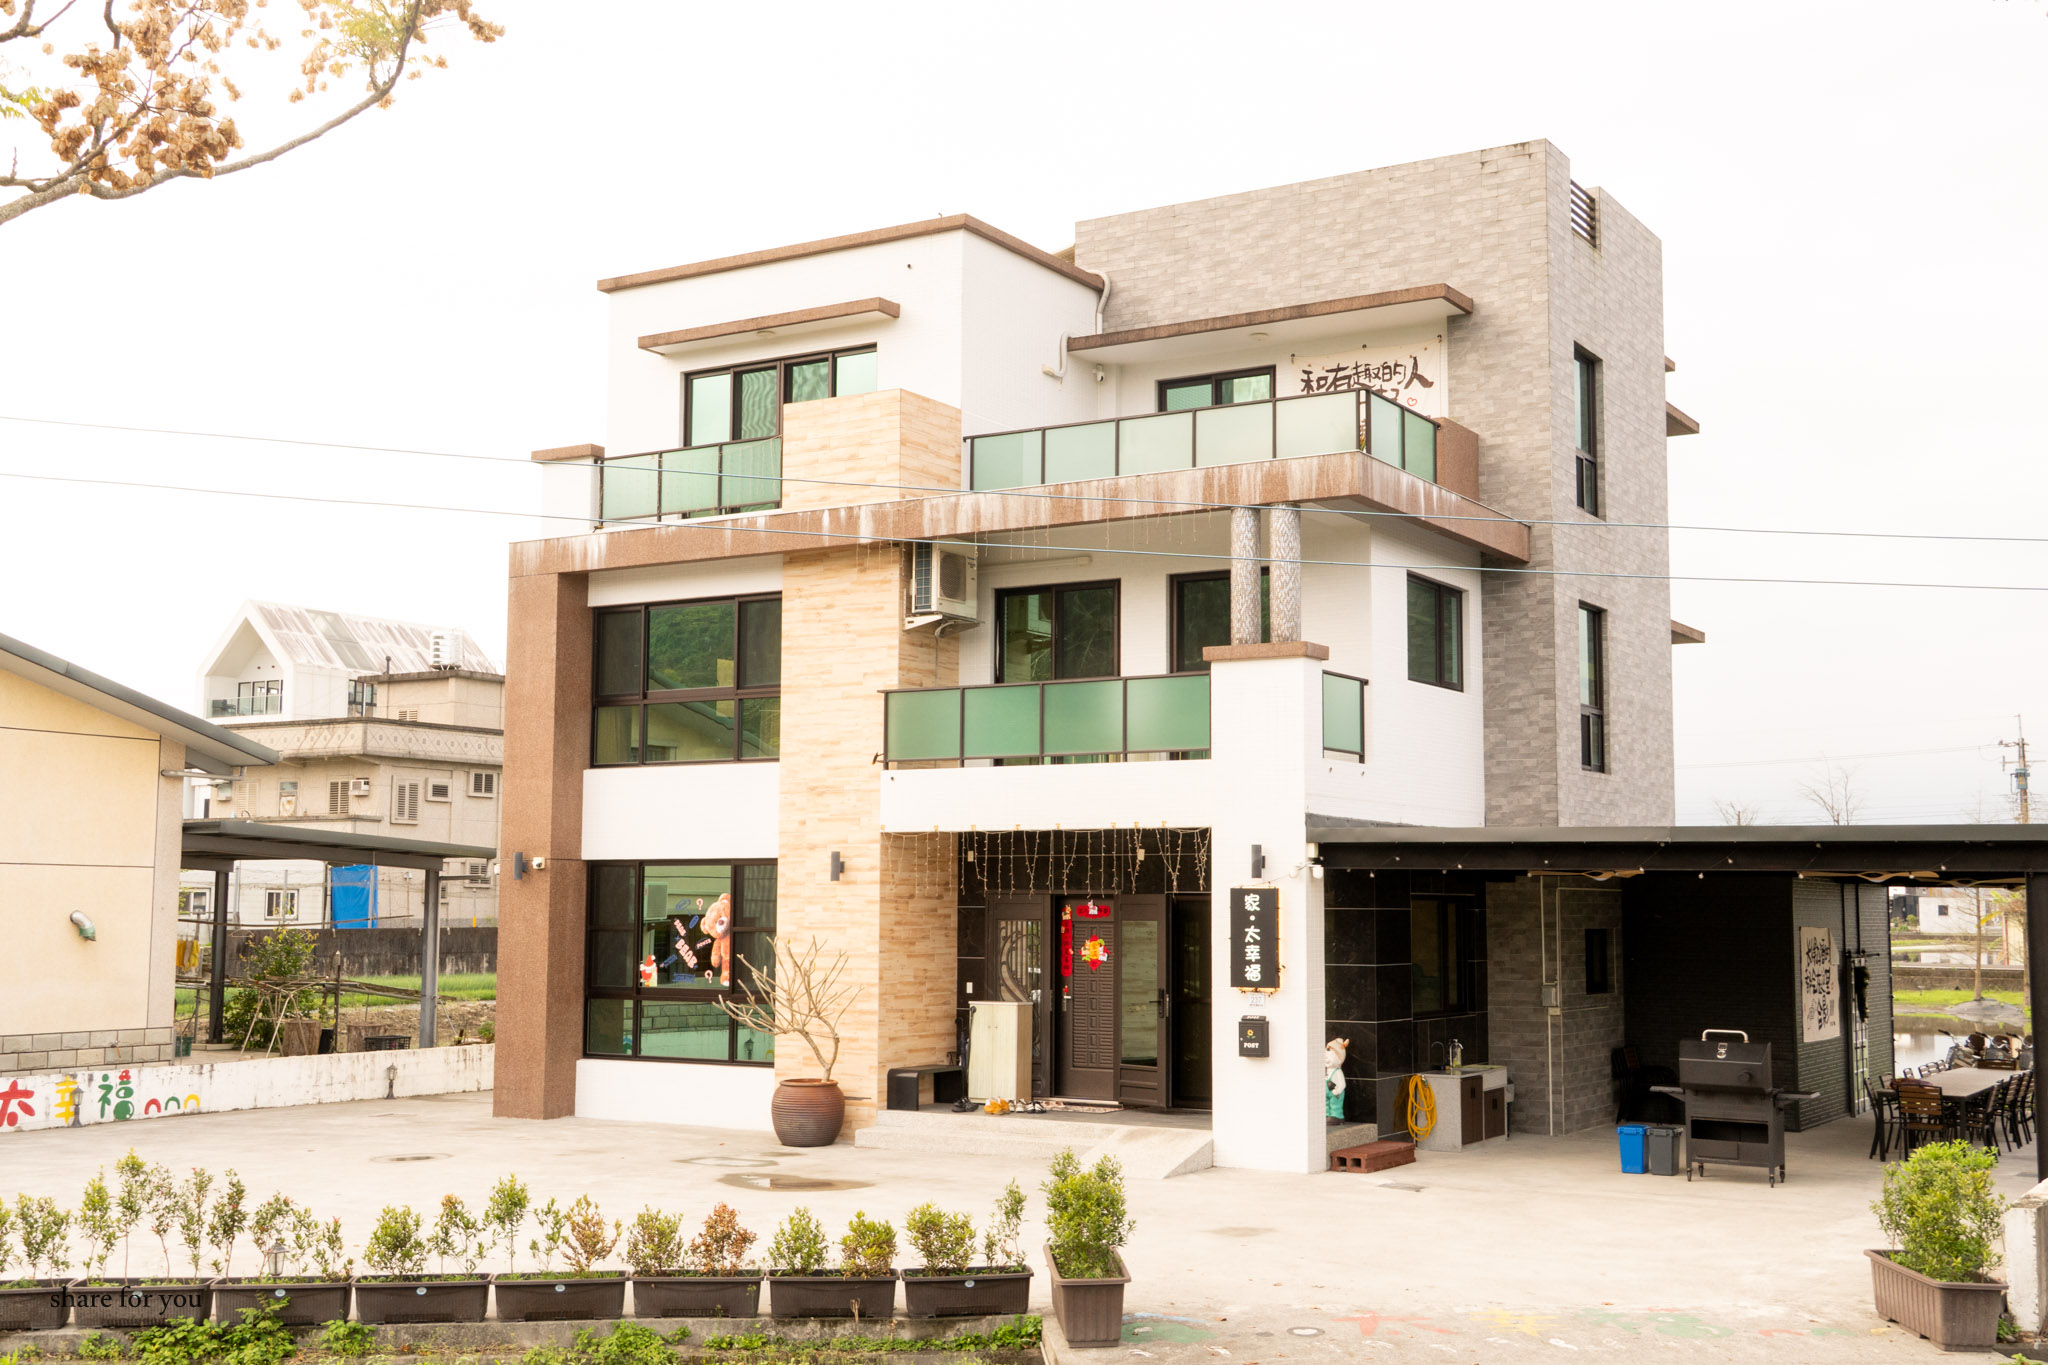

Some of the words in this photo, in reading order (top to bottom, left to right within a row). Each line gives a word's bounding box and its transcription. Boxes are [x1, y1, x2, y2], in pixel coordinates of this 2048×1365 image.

[1300, 356, 1434, 395] 和有趣的人
[675, 938, 697, 968] BEAR
